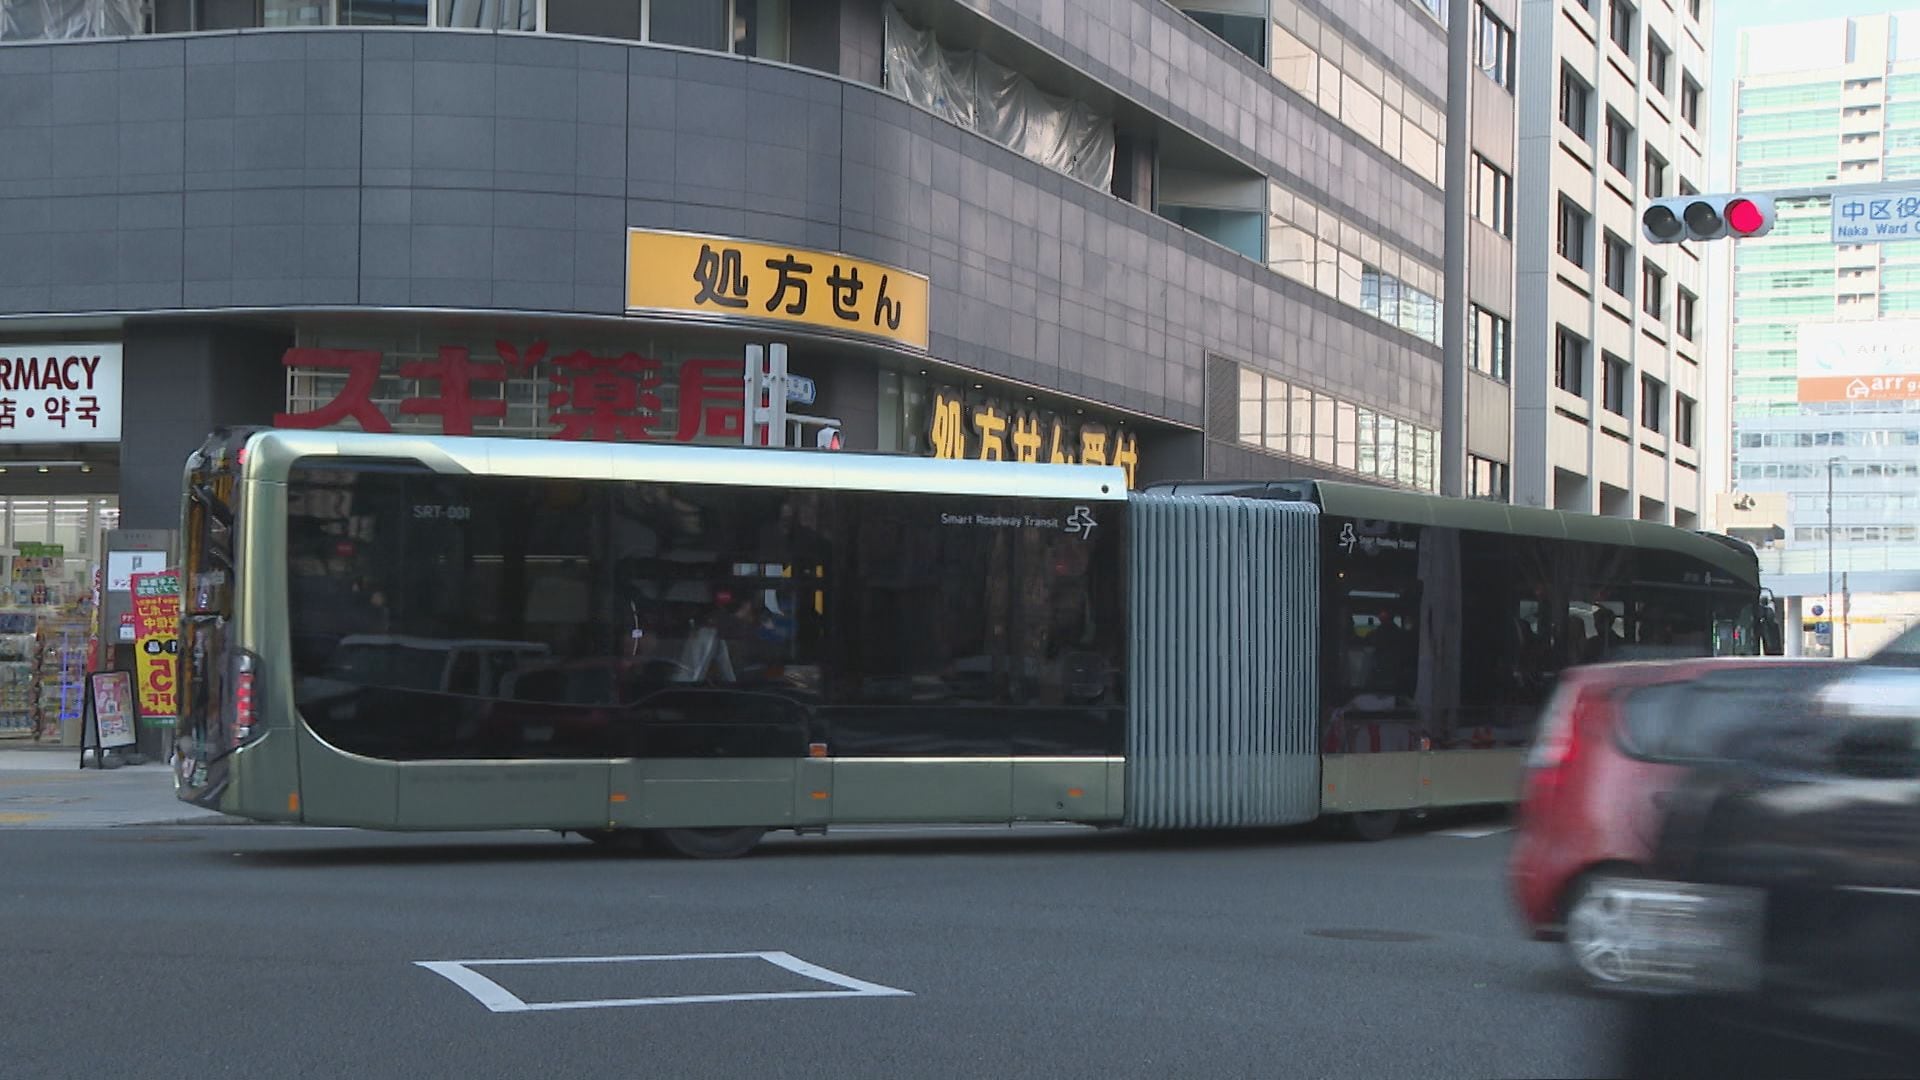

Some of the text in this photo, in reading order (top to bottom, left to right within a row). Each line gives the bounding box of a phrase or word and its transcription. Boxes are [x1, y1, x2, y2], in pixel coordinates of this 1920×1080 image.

[1838, 226, 1868, 236] Naka
[1876, 223, 1908, 234] Ward
[693, 244, 901, 330] 処方せん
[273, 340, 770, 447] スギ薬局
[932, 394, 1138, 490] 処方せん受付
[412, 504, 471, 520] SRT-001
[940, 512, 973, 525] Smart
[975, 514, 1022, 529] Roadway
[1024, 515, 1059, 529] Transit
